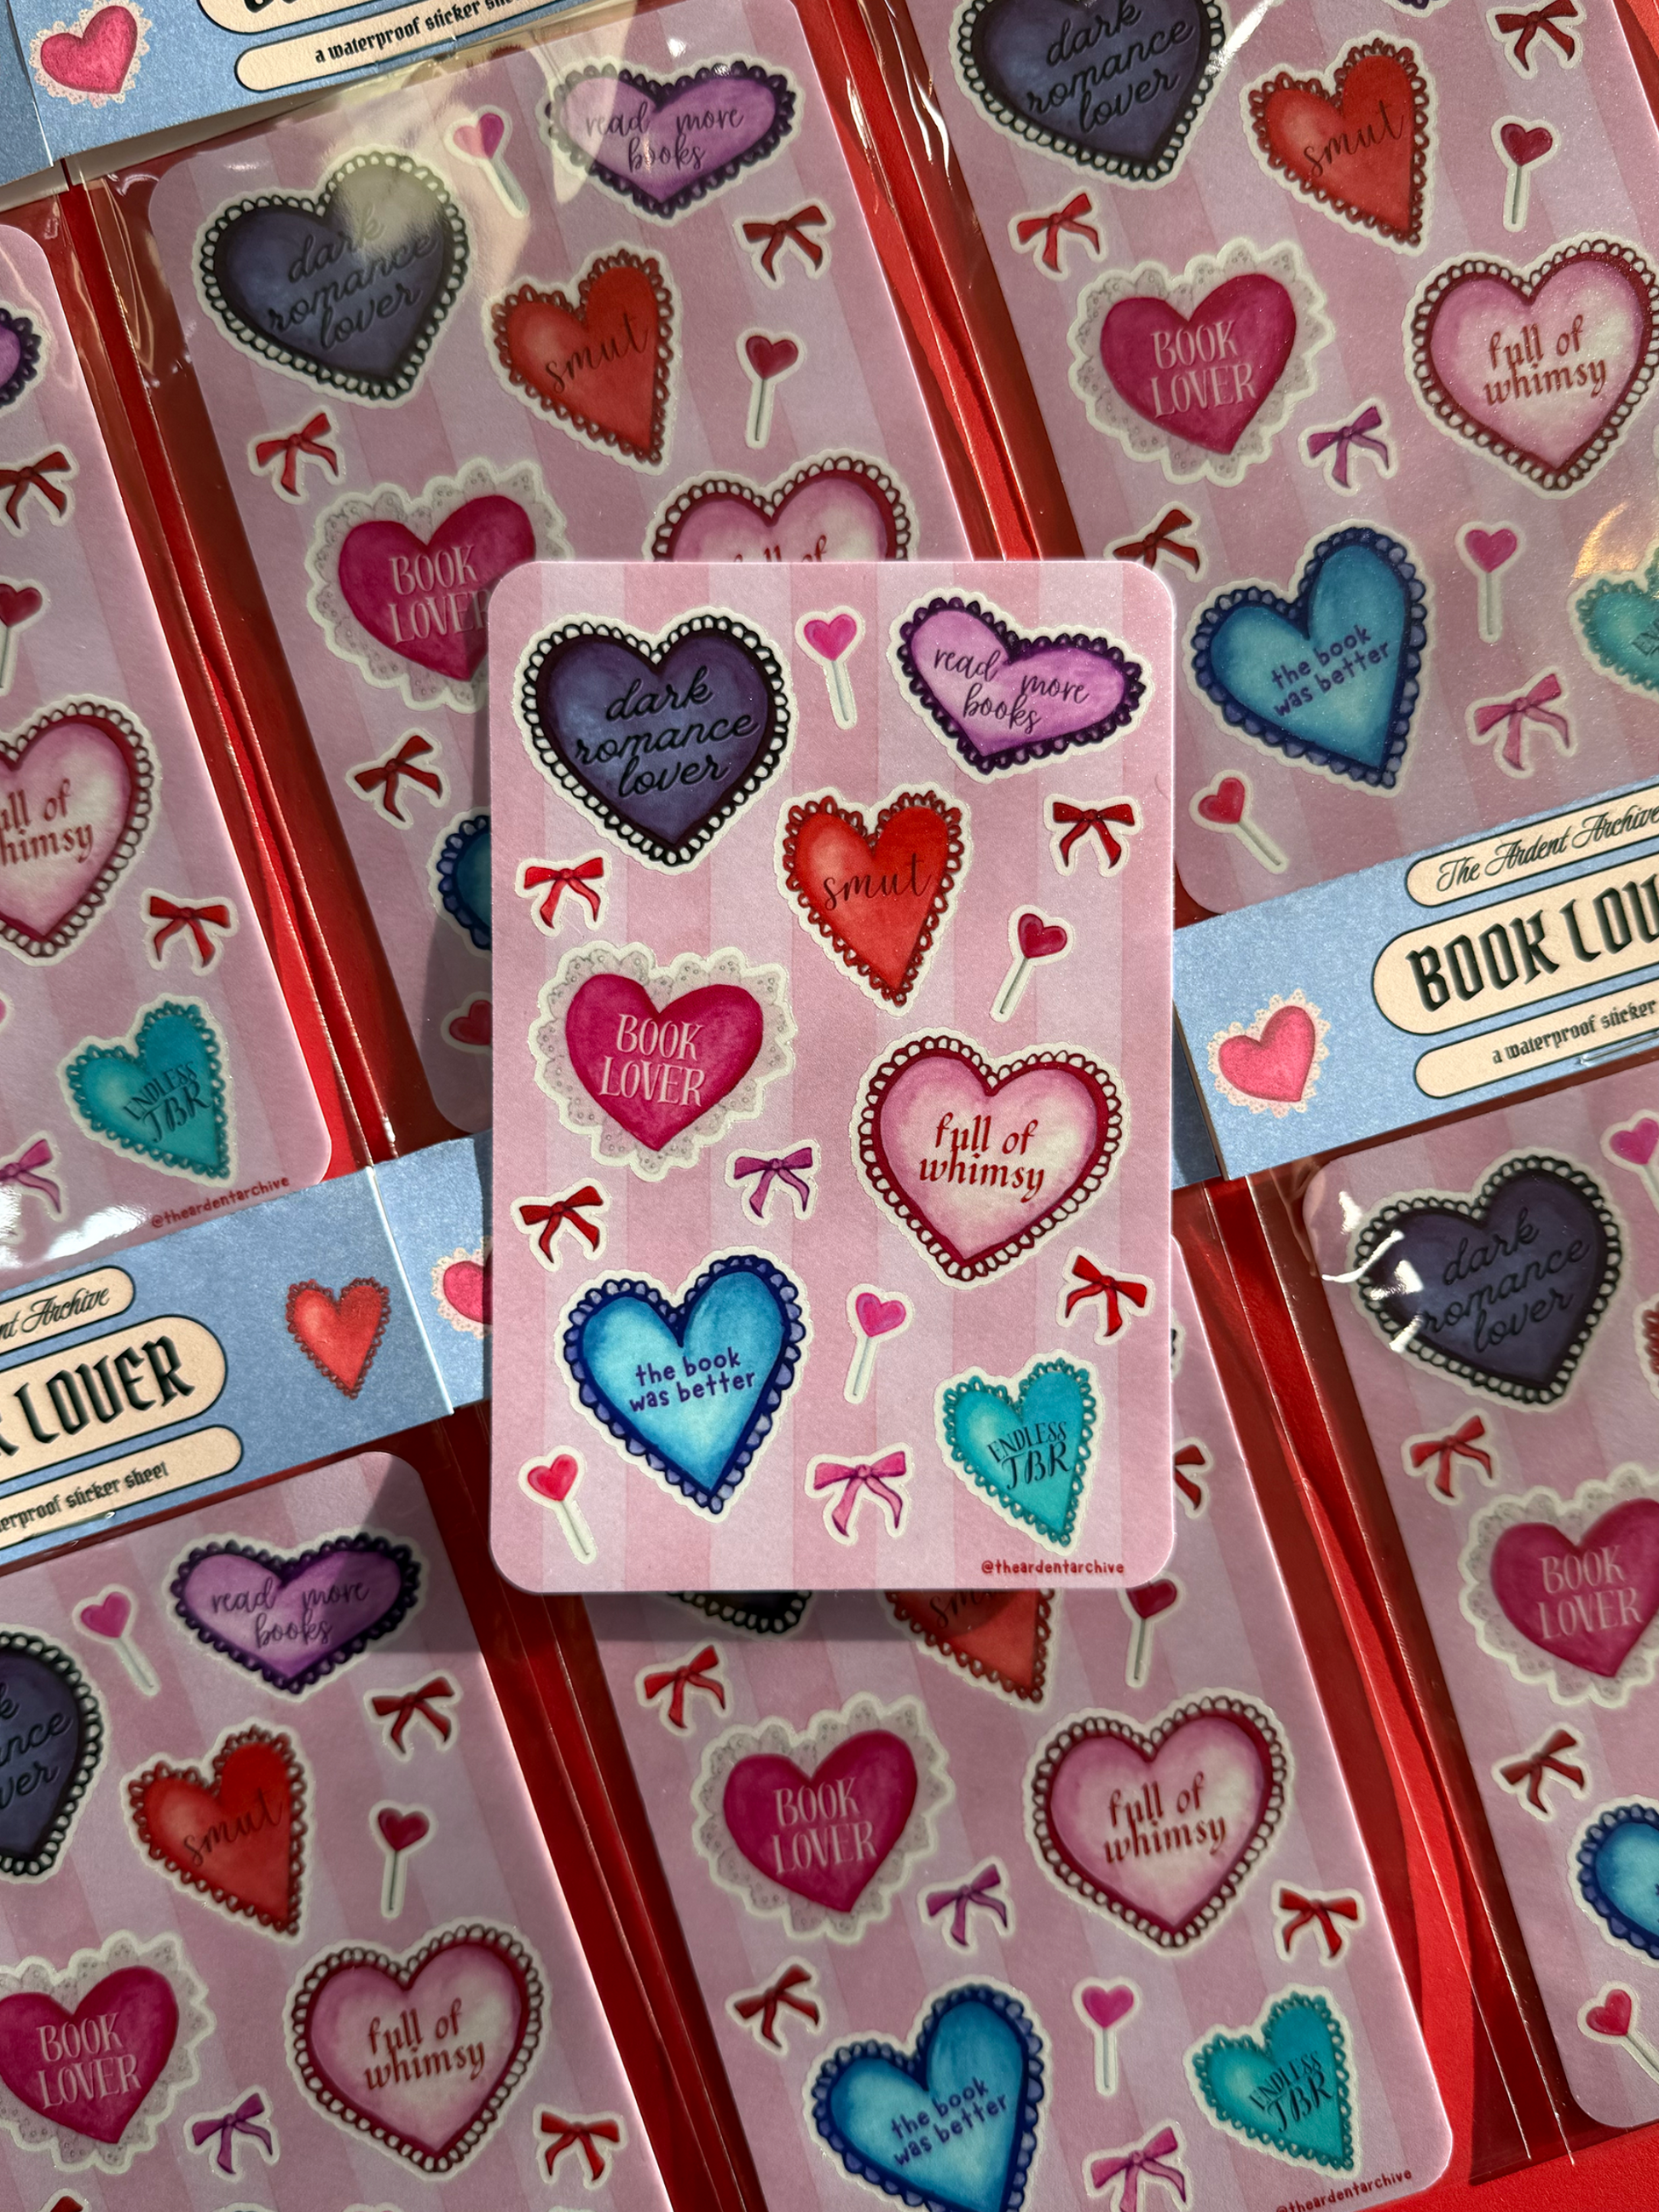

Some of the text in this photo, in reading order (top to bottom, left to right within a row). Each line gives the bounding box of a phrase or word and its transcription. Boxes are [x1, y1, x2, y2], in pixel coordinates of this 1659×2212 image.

[315, 1, 480, 64] a waterproof sticker
[1046, 0, 1142, 67] dark
[1027, 20, 1193, 114] romance
[586, 101, 744, 138] read more
[1078, 68, 1180, 133] lover
[628, 135, 705, 171] books
[1304, 98, 1408, 177] smut
[288, 202, 385, 283] dark
[269, 234, 438, 332] romance
[321, 283, 423, 350] lover
[1150, 319, 1239, 369] BOOK
[1488, 314, 1584, 371] full of
[546, 313, 649, 394] smut
[1483, 356, 1607, 406] whimsy
[1149, 363, 1256, 419] LOVER
[389, 545, 478, 595] BOOK
[934, 649, 1090, 704] read more
[1271, 624, 1373, 689] the book
[1273, 640, 1390, 718] was better
[606, 665, 713, 721] dark
[963, 682, 1041, 734] books
[575, 714, 758, 764] romance
[44, 778, 71, 821] of
[619, 755, 729, 798] lover
[1436, 804, 1659, 892] The Ardent Archive
[822, 853, 933, 911] smut
[1405, 908, 1560, 1013] BOOK
[616, 1014, 703, 1061] BOOK
[1492, 999, 1657, 1065] a waterproof sticker
[124, 1062, 197, 1121] ENDLESS
[599, 1056, 706, 1107] LOVER
[143, 1079, 212, 1144] TBR
[935, 1112, 1038, 1155] full of
[151, 1177, 290, 1228] @theardentarchive
[919, 1149, 1044, 1203] whimsy
[1442, 1207, 1540, 1286] dark
[21, 1287, 110, 1333] Archive
[1422, 1239, 1591, 1333] romance
[1473, 1288, 1574, 1352] lover
[14, 1335, 195, 1444] LOVER
[629, 1371, 755, 1412] was better
[635, 1346, 741, 1387] the book
[987, 1422, 1067, 1463] ENDLESS
[1001, 1442, 1073, 1491] TBR
[65, 1479, 121, 1508] sticker
[124, 1461, 169, 1489] sheet
[981, 1560, 1124, 1574] @theardentarchive
[1540, 1545, 1625, 1595] BOOK
[212, 1578, 370, 1615] read more
[1537, 1587, 1645, 1641] LOVER
[256, 1610, 333, 1648] books
[774, 1776, 861, 1827] BOOK
[1108, 1770, 1205, 1827] full of
[184, 1787, 283, 1867] smut
[772, 1820, 877, 1875] LOVER
[1104, 1816, 1226, 1864] whimsy
[37, 2011, 125, 2063] BOOK
[368, 1997, 463, 2056] full of
[38, 2053, 142, 2110] LOVER
[364, 2039, 485, 2091] whimsy
[1249, 2050, 1322, 2111] ENDLESS
[891, 2076, 989, 2140] the book
[1267, 2069, 1335, 2132] TBR
[893, 2093, 1009, 2167] was better
